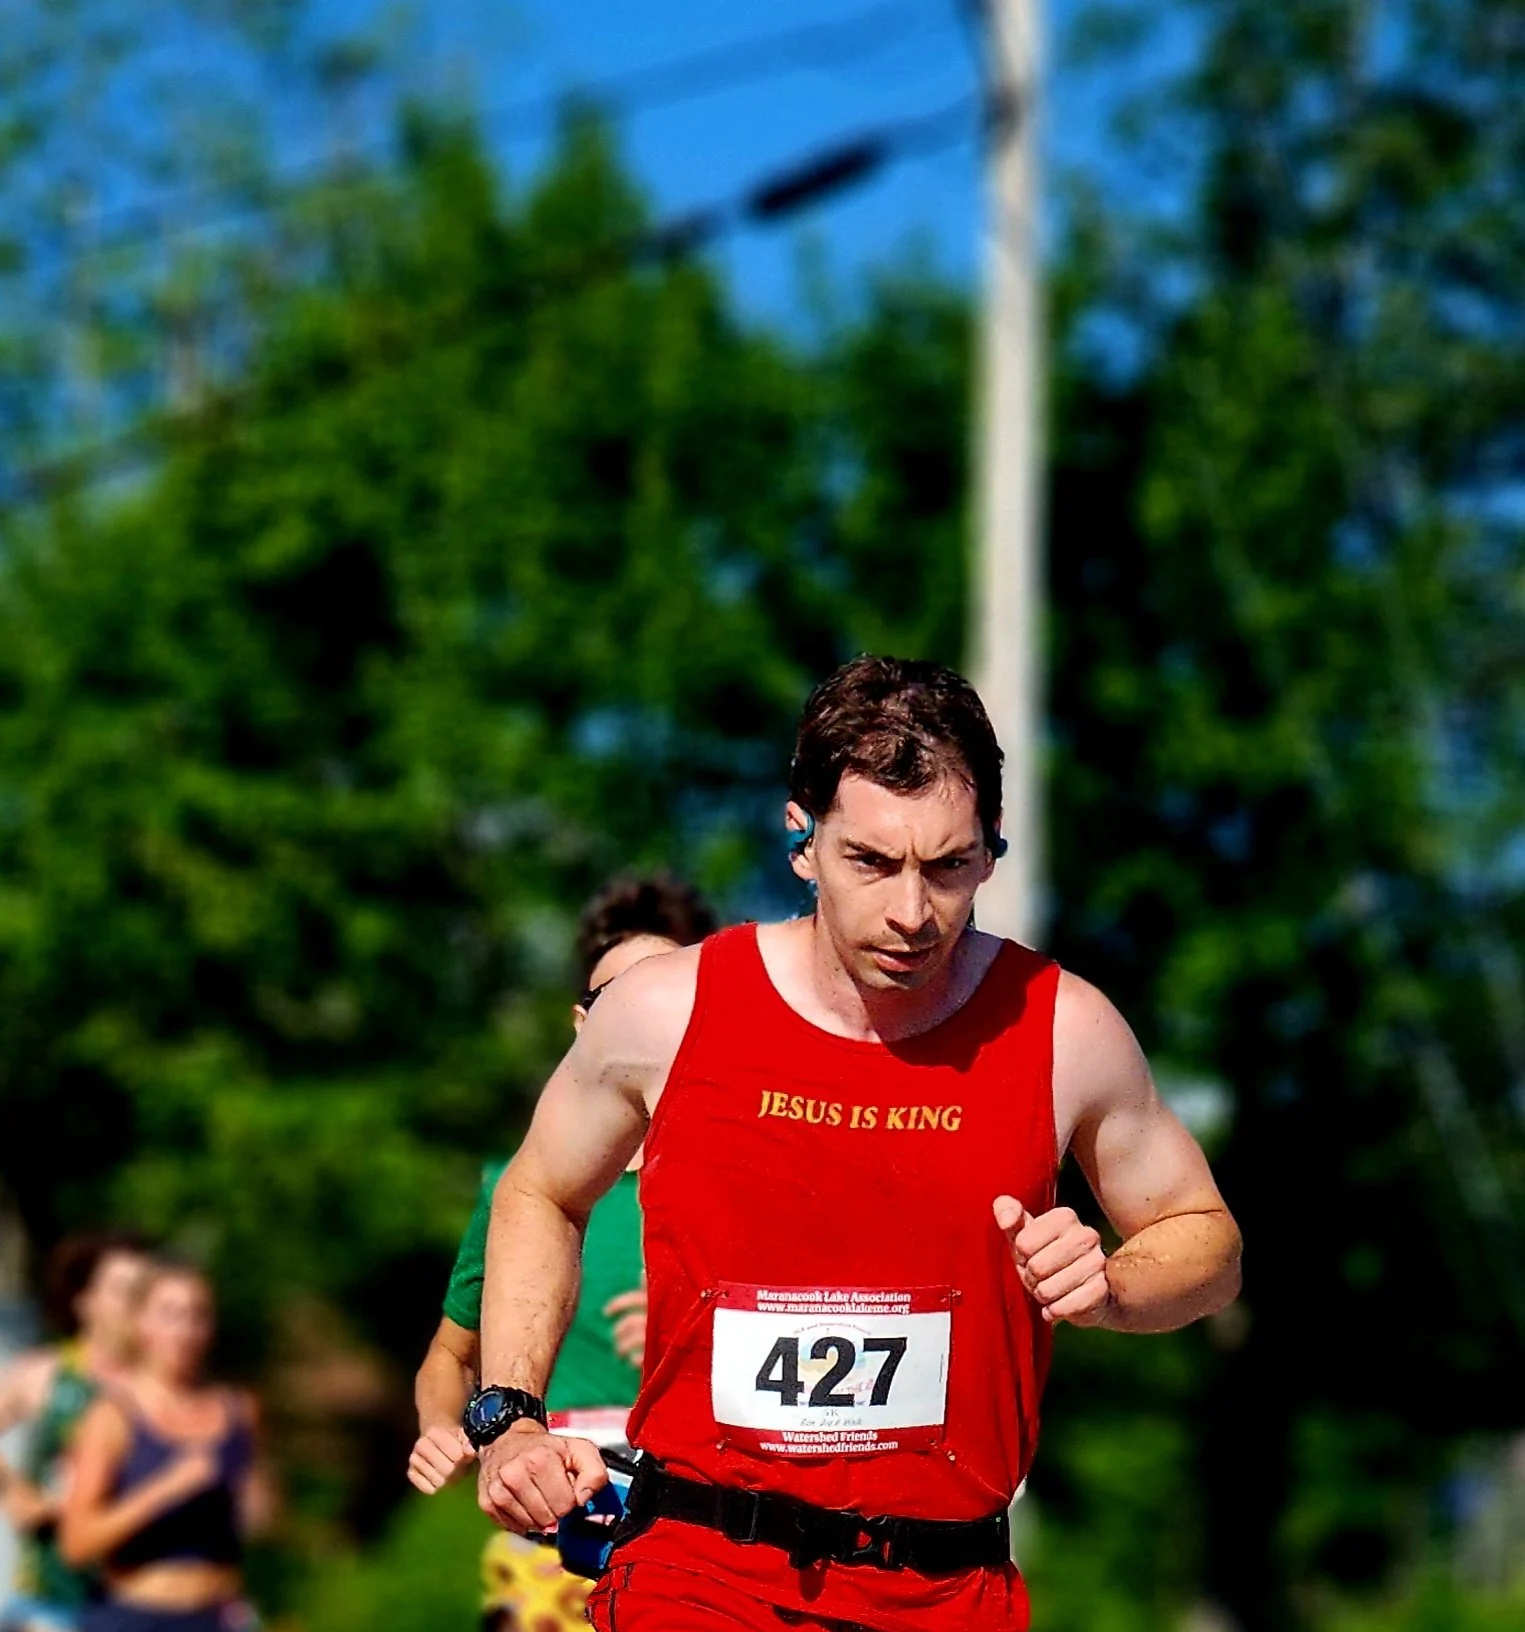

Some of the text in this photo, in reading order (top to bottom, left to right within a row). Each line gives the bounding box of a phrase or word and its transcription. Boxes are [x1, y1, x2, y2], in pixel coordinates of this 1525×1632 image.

[757, 1090, 963, 1131] JESUS IS KING
[756, 1289, 912, 1303] Maranacook Lake Association
[755, 1336, 908, 1408] 427
[782, 1430, 878, 1442] Watershed Friends
[760, 1441, 899, 1454] www.watershedfriends.com
